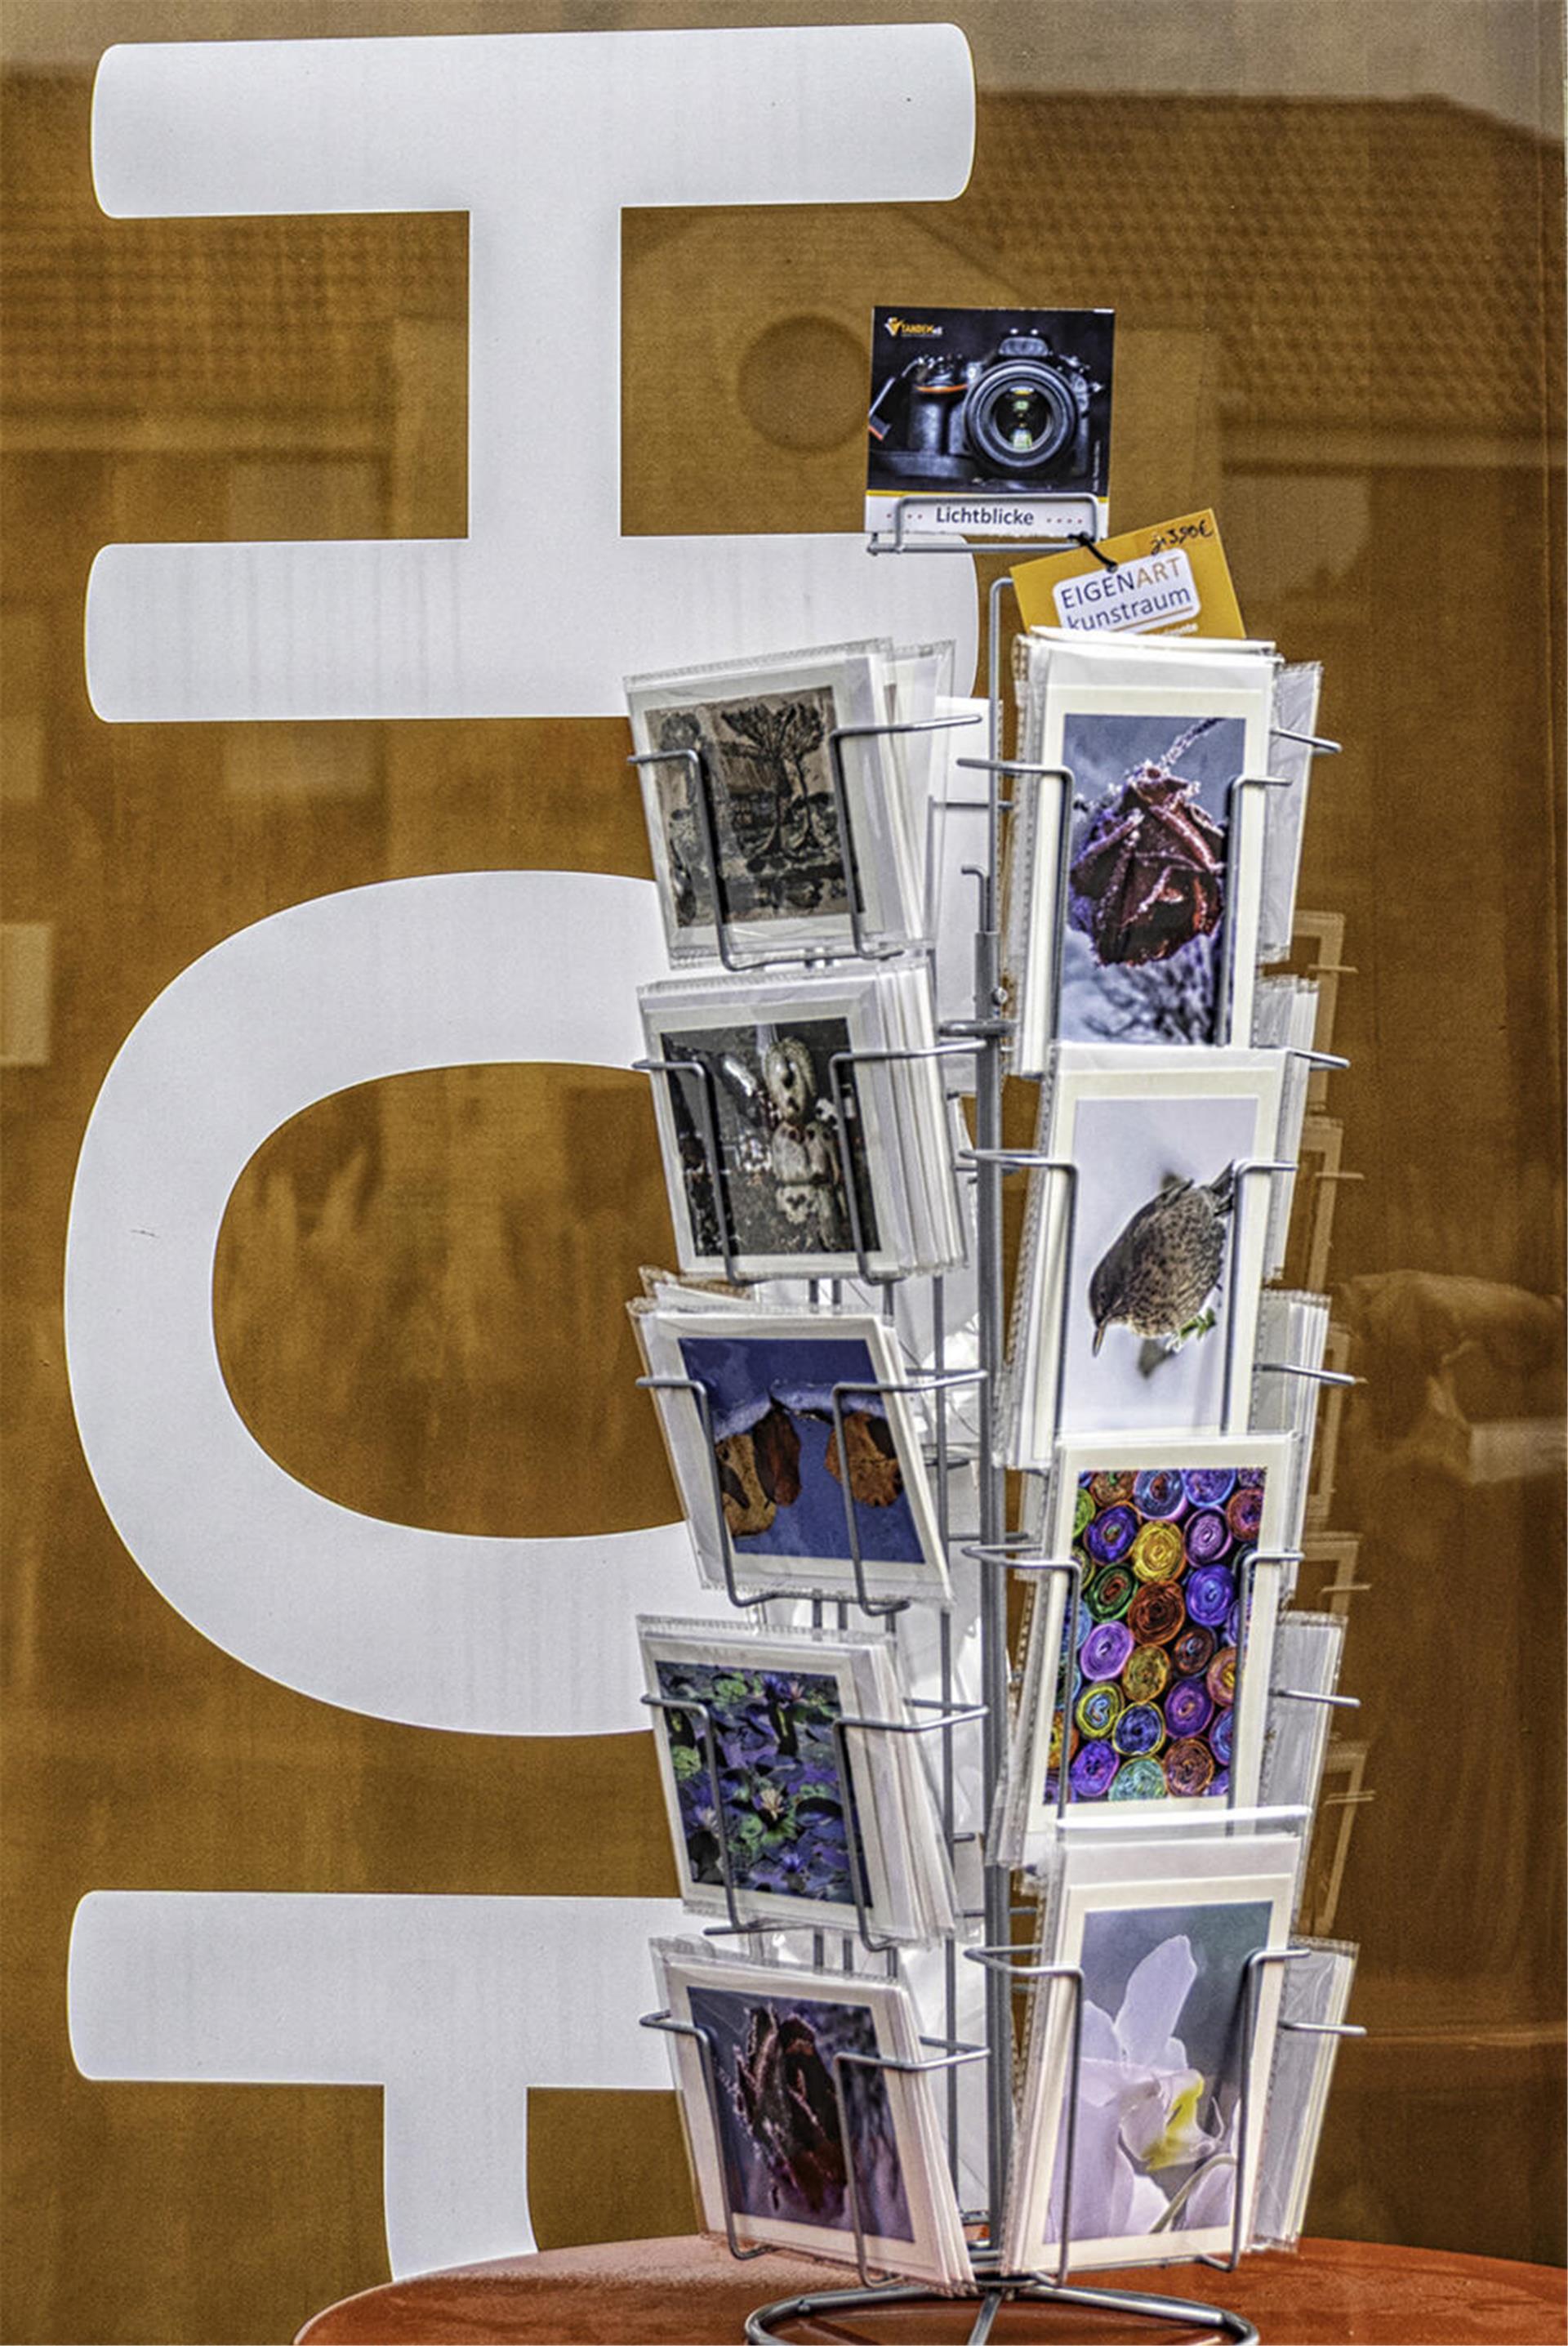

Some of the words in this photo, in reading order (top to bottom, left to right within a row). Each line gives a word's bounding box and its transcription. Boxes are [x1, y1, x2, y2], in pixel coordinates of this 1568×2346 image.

[936, 506, 1034, 525] Lichtblicke
[1061, 556, 1181, 609] EIGENART
[1067, 587, 1192, 631] kunstraum
